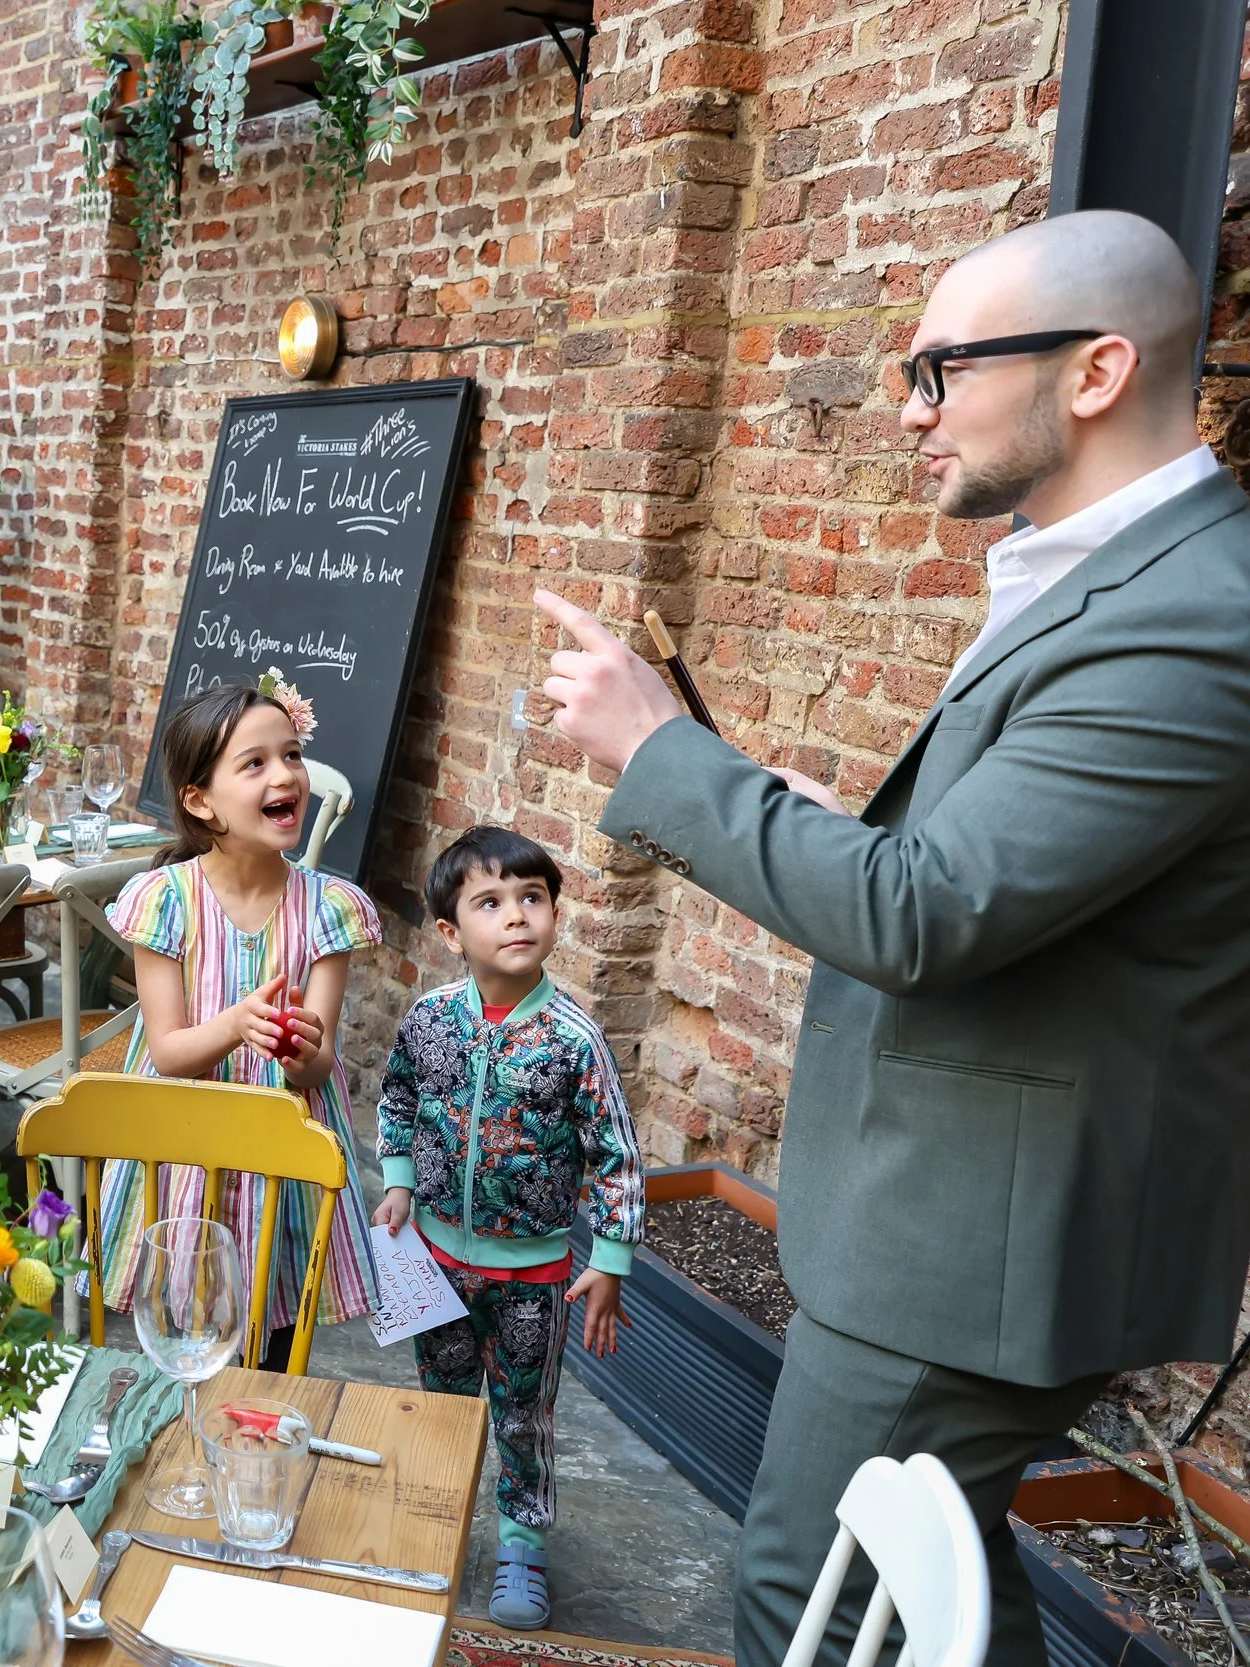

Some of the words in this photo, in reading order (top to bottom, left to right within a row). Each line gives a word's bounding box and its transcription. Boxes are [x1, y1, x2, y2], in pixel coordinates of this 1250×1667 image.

[297, 443, 329, 453] VICTORIA
[330, 442, 358, 452] STAKES
[219, 460, 256, 518] Book
[259, 457, 291, 517] Now
[296, 467, 318, 515] For
[329, 467, 377, 512] World
[380, 468, 426, 523] Cup!
[194, 610, 231, 650] 50%
[283, 642, 293, 654] on
[298, 631, 356, 681] Wednesday
